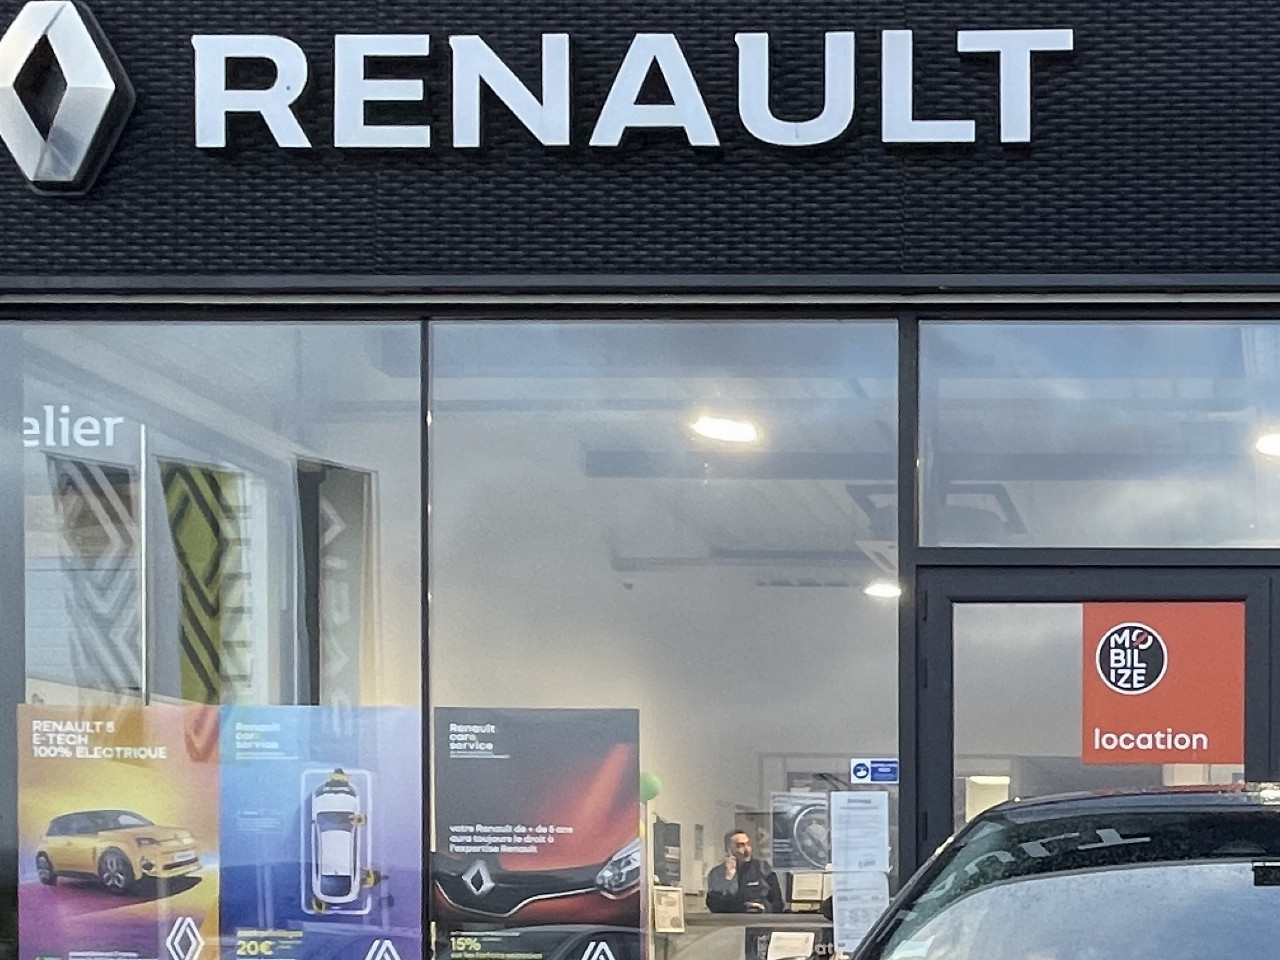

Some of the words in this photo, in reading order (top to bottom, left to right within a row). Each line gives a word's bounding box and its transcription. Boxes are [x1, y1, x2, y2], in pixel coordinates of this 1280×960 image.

[192, 29, 1074, 148] RENAULT
[32, 720, 103, 733] RENAULT
[449, 723, 496, 734] Renault
[32, 733, 88, 745] E-TECH
[1094, 727, 1208, 750] location
[33, 747, 73, 758] 100%
[236, 940, 274, 956] 20€
[450, 936, 482, 951] 15%
